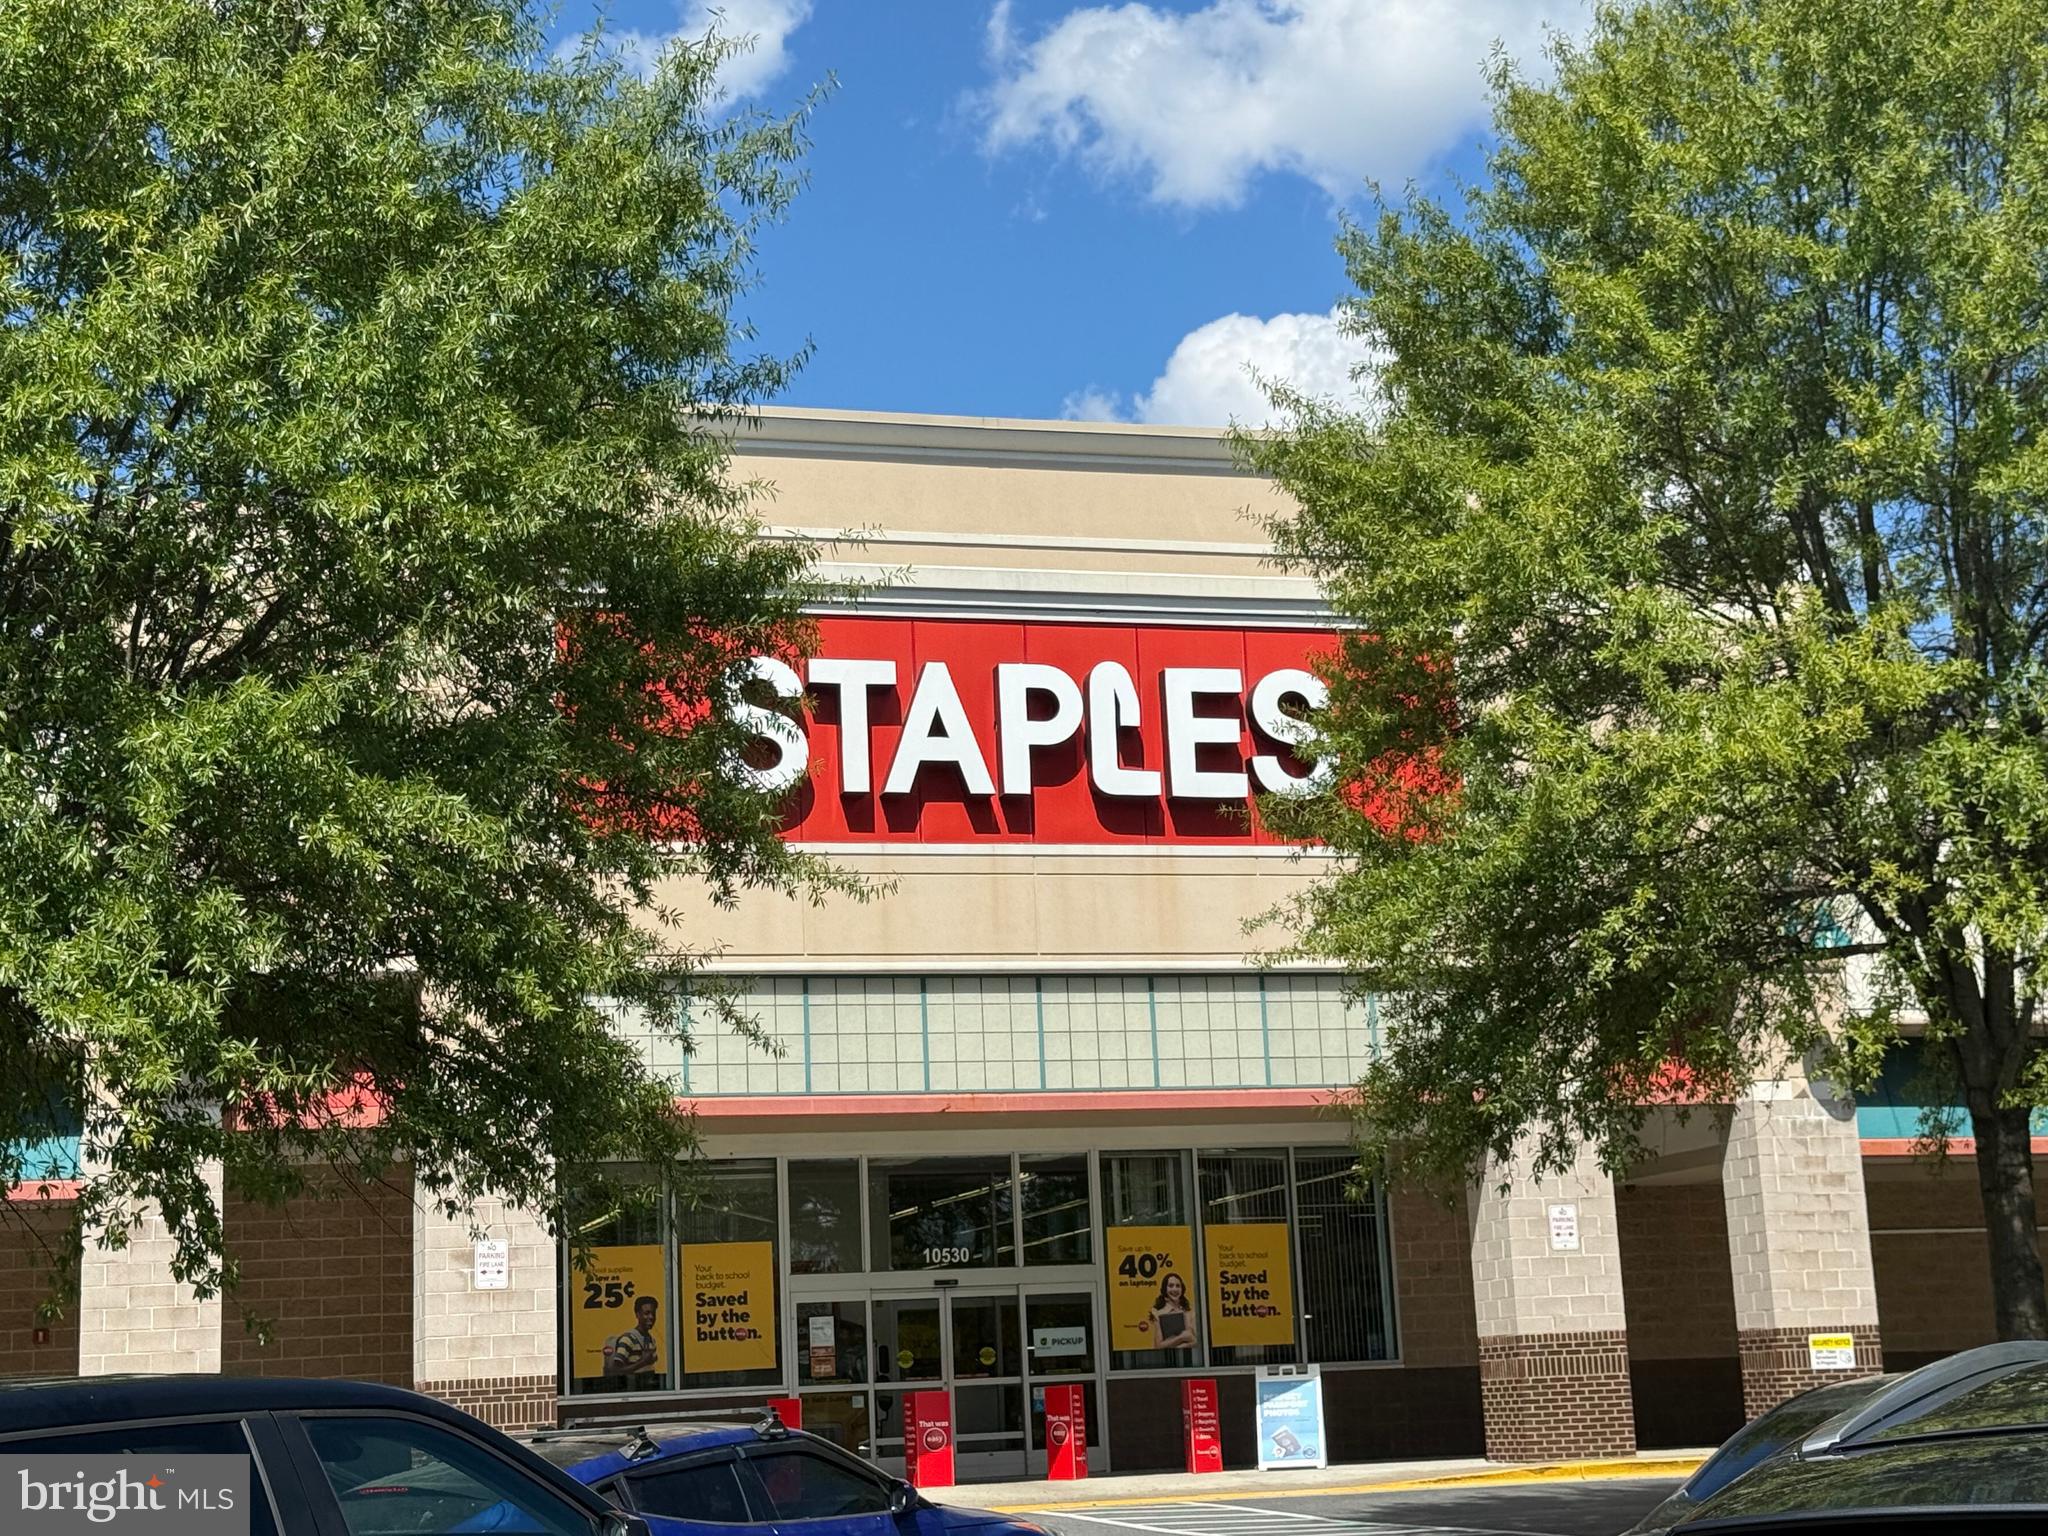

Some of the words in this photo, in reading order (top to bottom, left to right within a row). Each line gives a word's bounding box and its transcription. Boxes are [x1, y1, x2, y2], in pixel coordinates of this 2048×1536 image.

[717, 656, 1341, 801] STAPLES
[923, 1247, 969, 1263] 10530
[695, 1264, 712, 1272] Your
[1119, 1252, 1173, 1278] 40%
[725, 1271, 750, 1280] school
[1219, 1269, 1268, 1285] Saved
[1130, 1280, 1157, 1288] laptops
[584, 1281, 634, 1308] 25¢
[695, 1290, 748, 1308] Saved
[1221, 1287, 1240, 1304] by
[1243, 1286, 1270, 1300] the
[696, 1310, 718, 1328] by
[721, 1308, 750, 1324] the
[1051, 1336, 1084, 1346] PICKUP
[918, 1420, 934, 1428] That
[926, 1435, 943, 1443] easy
